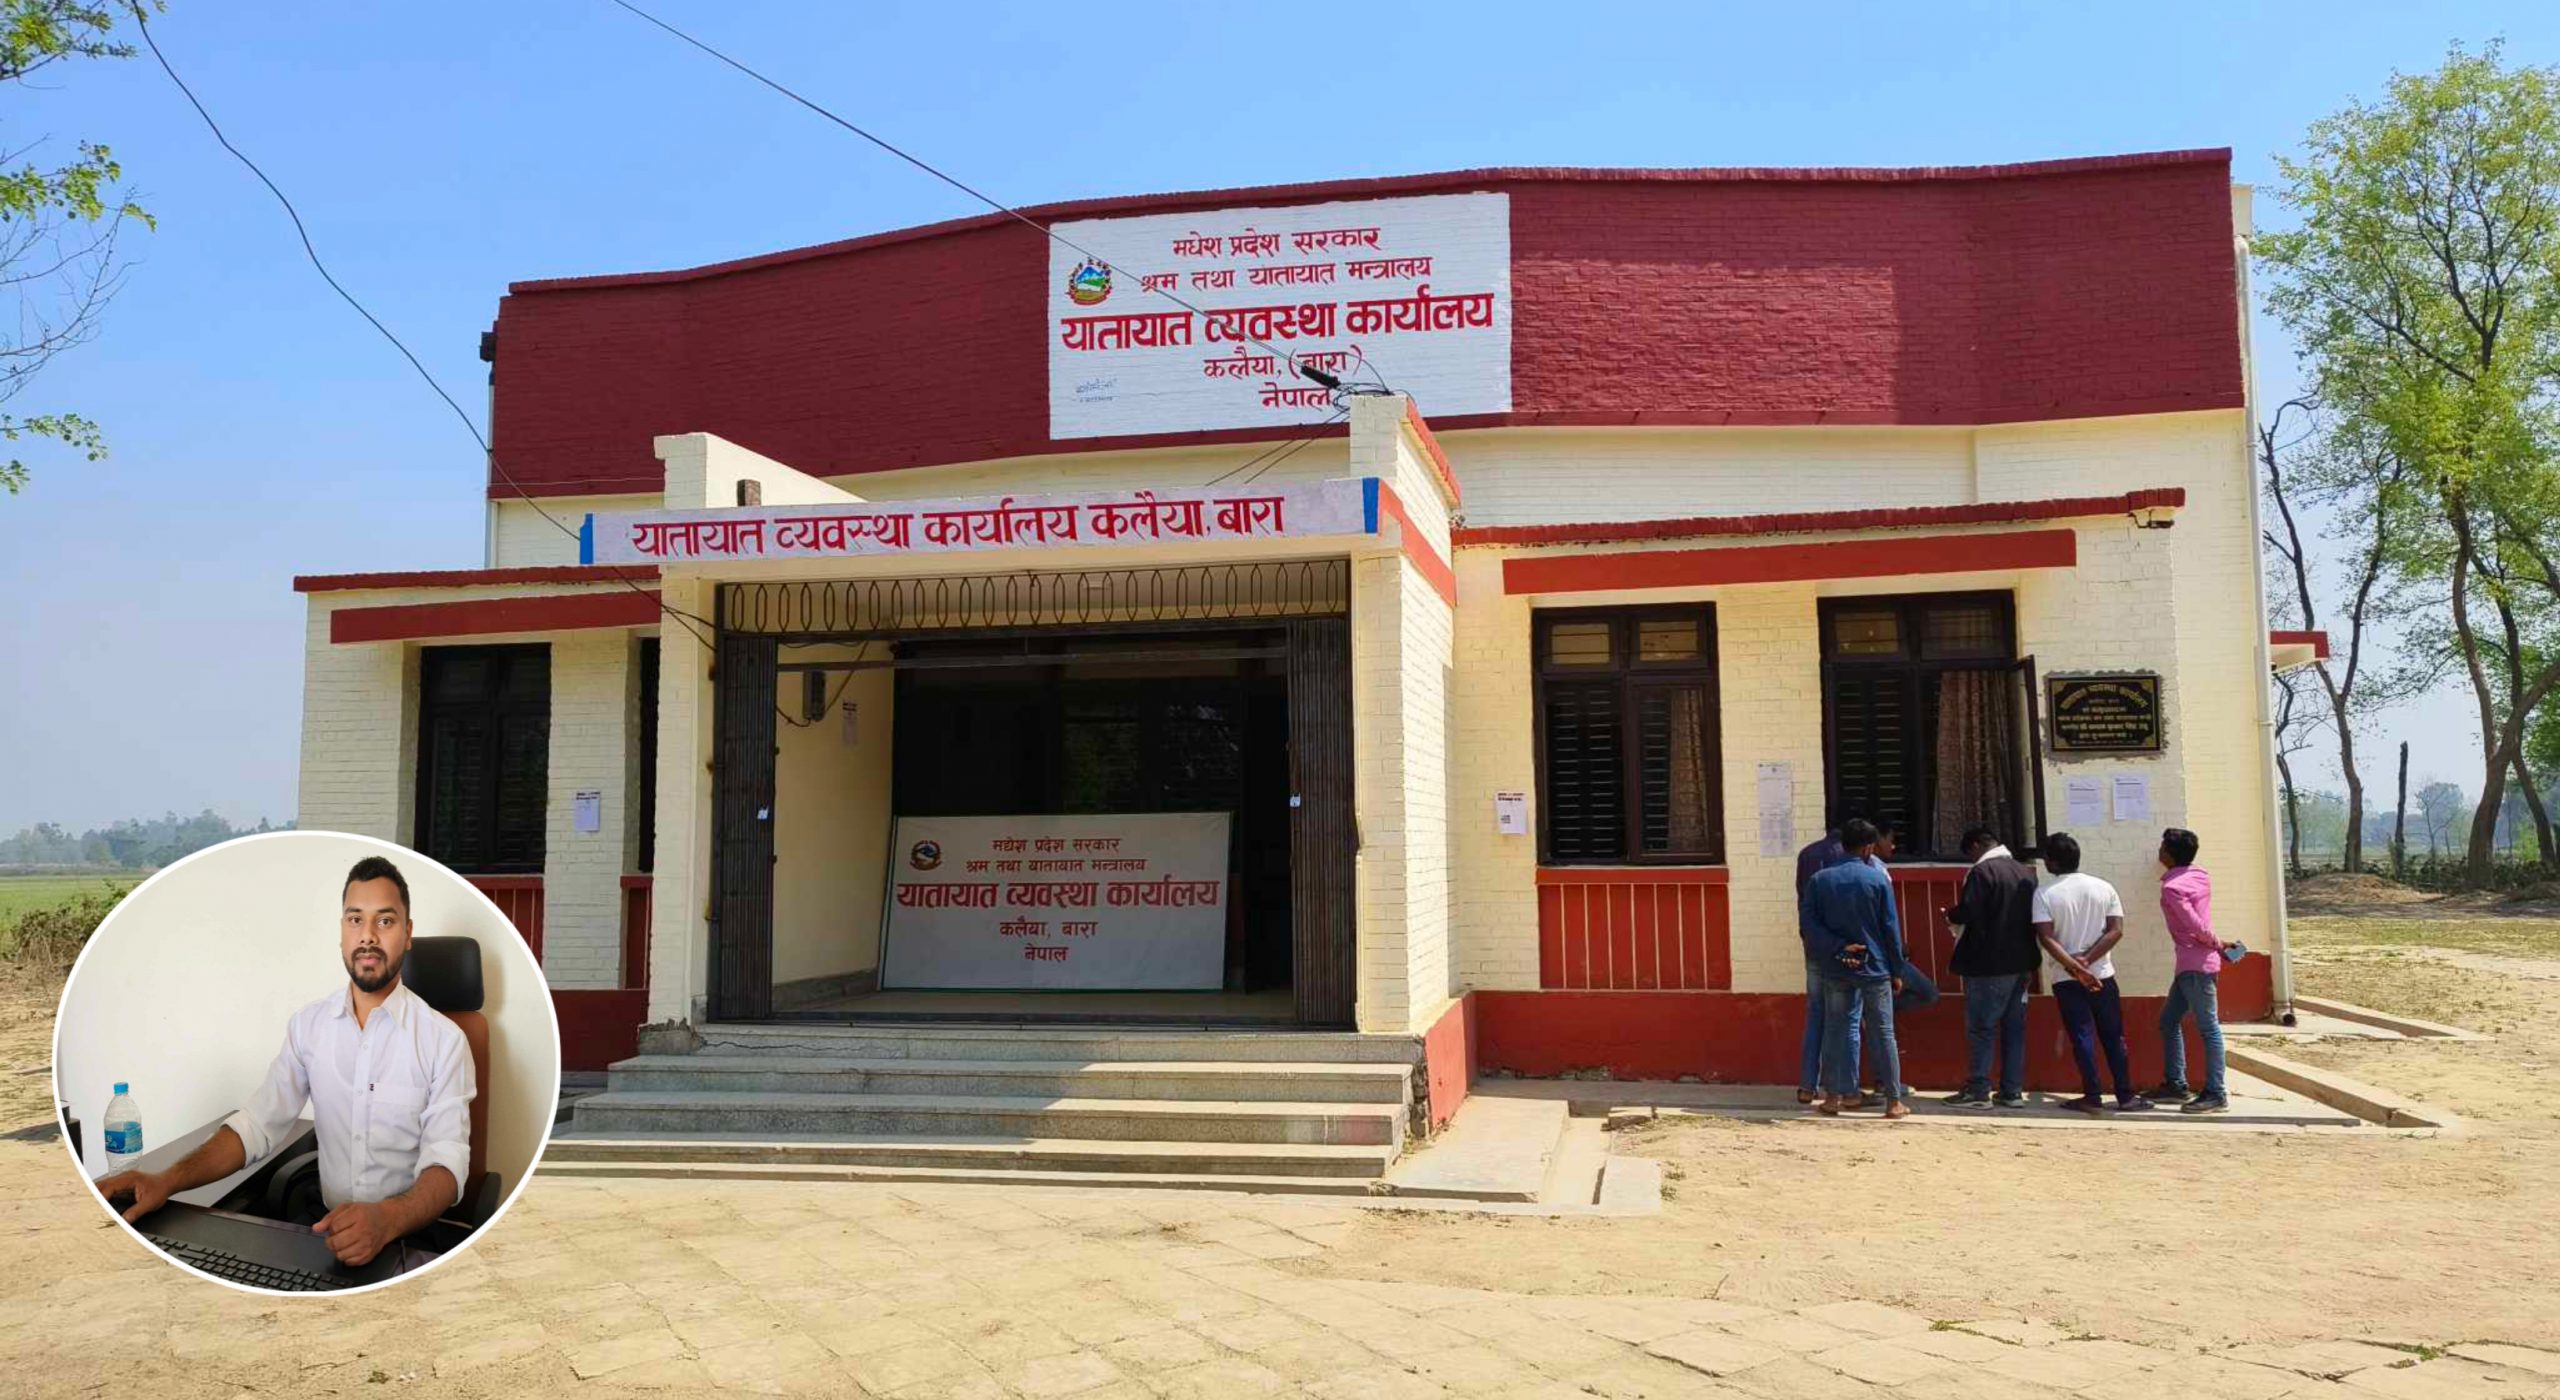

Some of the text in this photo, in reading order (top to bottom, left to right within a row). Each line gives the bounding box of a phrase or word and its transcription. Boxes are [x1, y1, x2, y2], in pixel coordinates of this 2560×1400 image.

[1173, 227, 1383, 259] मधेश प्रदेश सरकार
[1141, 257, 1433, 293] श्रम तथा यातायात मन्त्रालय
[1061, 283, 1495, 352] यातायात व्यवस्था कार्यालय
[1203, 345, 1283, 380] कलैया,
[1258, 381, 1331, 412] नेपाल
[632, 519, 767, 557] यातायात
[773, 512, 914, 551] व्यवस्था
[921, 497, 1080, 547] कार्यालय
[1212, 496, 1285, 534] बारा
[1034, 836, 1065, 854] प्रदेश
[1072, 838, 1122, 854] सरकार
[965, 859, 991, 873] श्रम
[896, 873, 1221, 910] यातायात व्यवस्था कार्यालय
[1061, 921, 1098, 938] बारा
[1024, 943, 1069, 963] नेपाल
